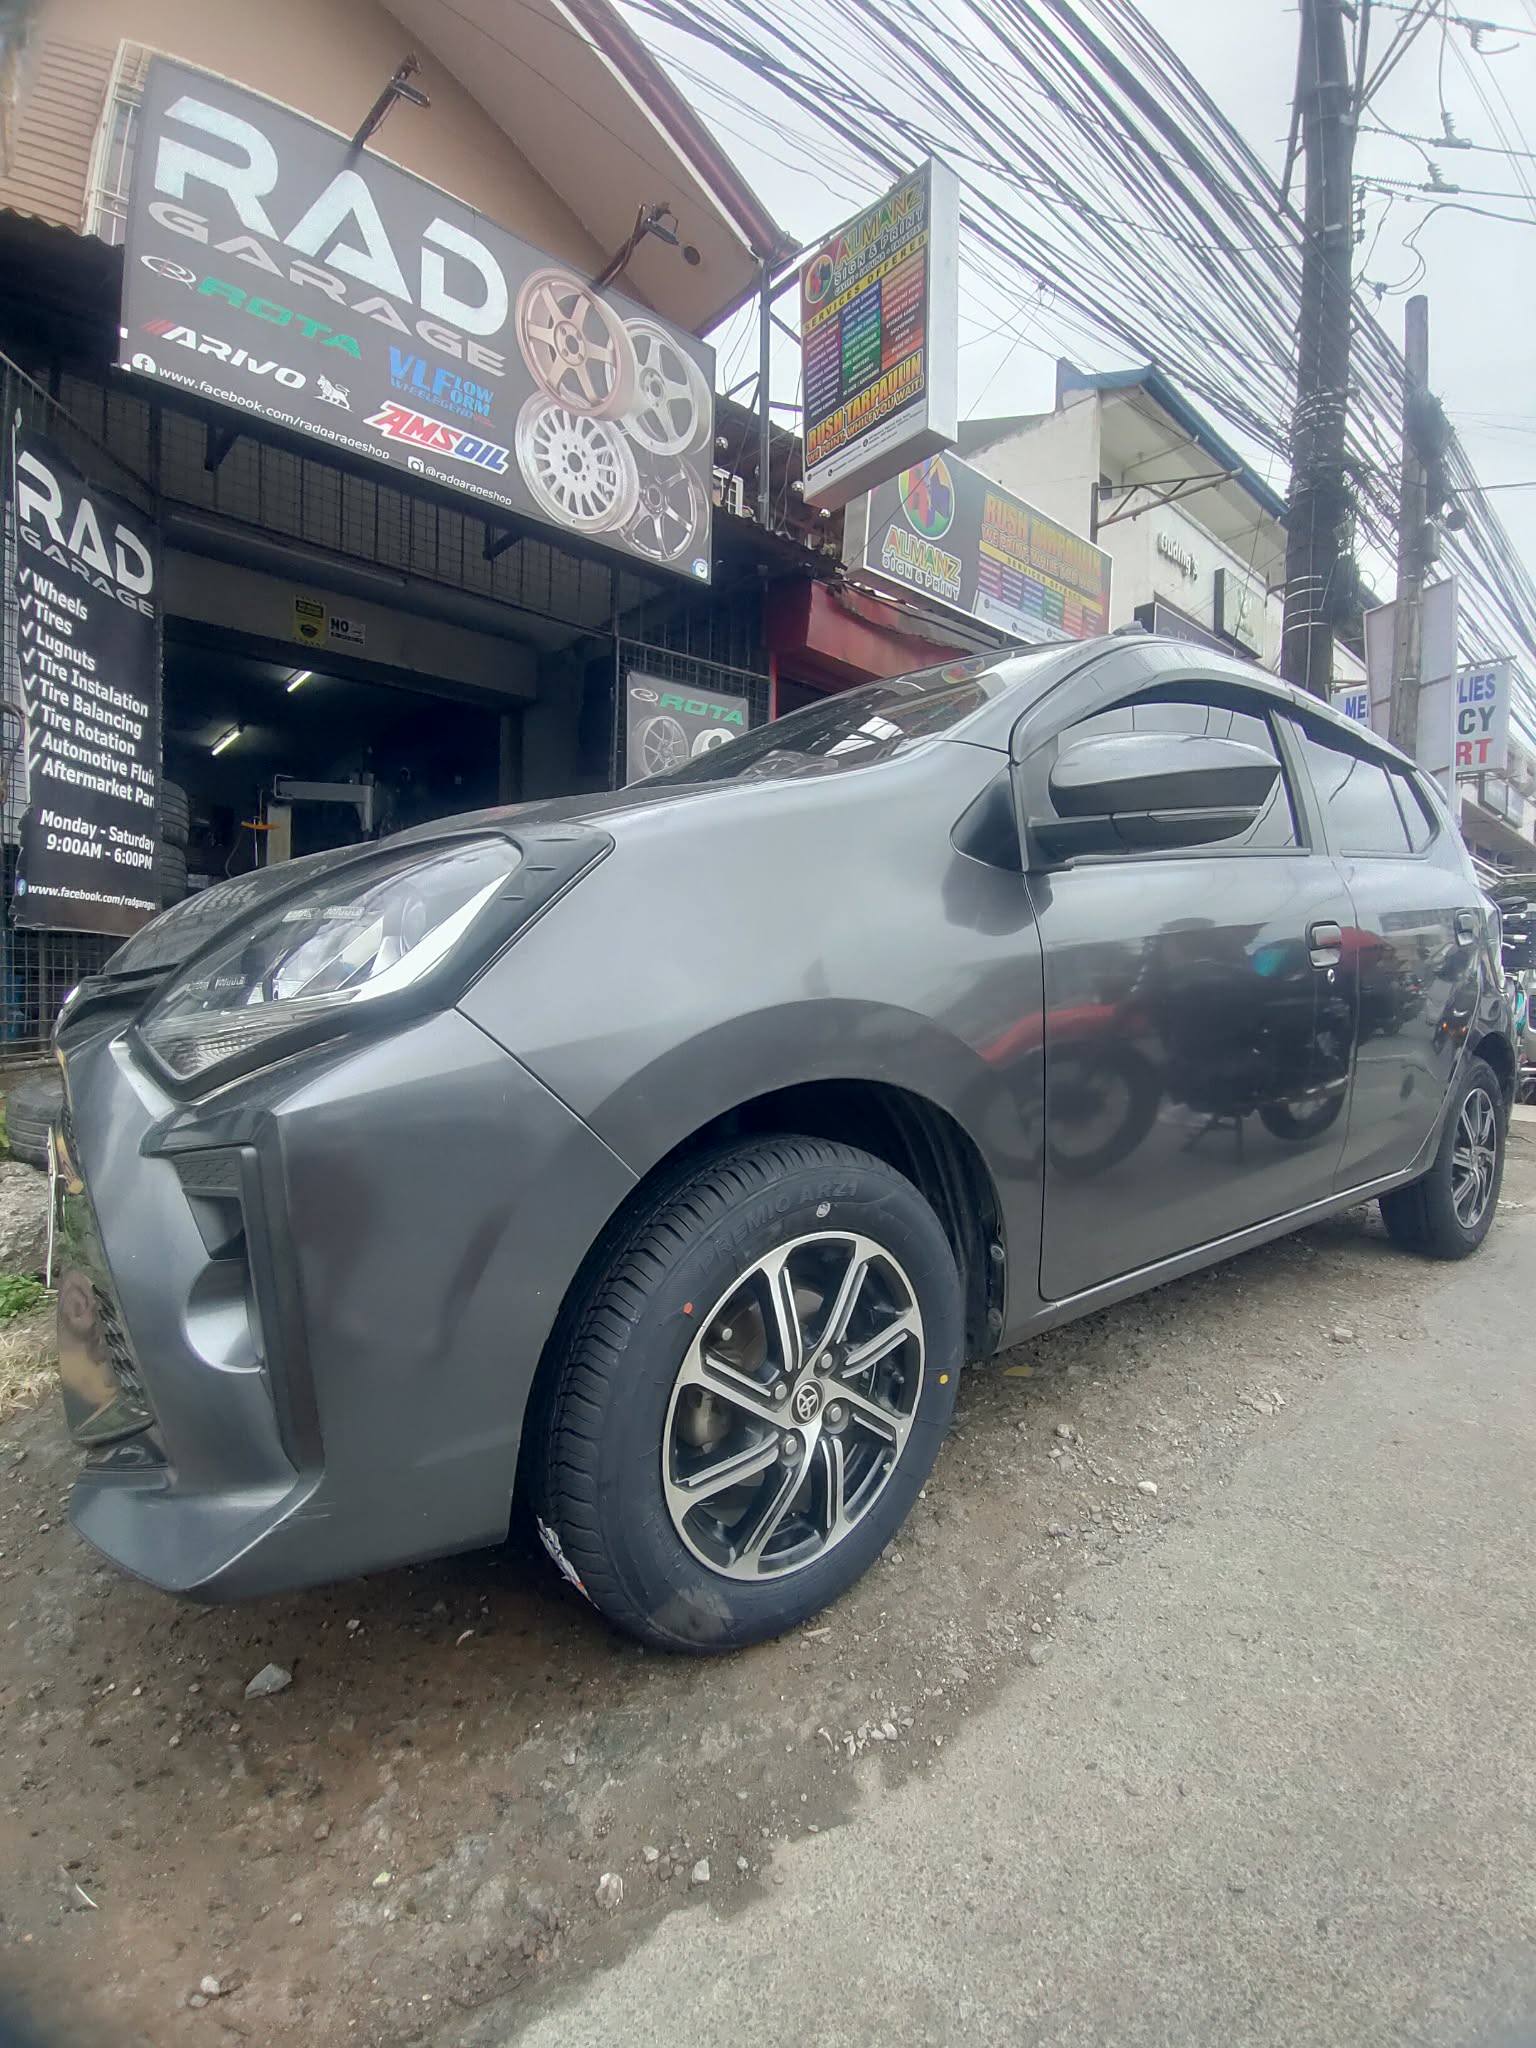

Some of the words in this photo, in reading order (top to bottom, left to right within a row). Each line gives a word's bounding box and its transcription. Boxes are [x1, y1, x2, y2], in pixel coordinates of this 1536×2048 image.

[155, 96, 508, 336] RAD
[834, 184, 925, 271] ALMANZ
[834, 253, 866, 286] SIGN
[880, 208, 924, 250] PRINT
[148, 202, 506, 376] GARAGE
[804, 284, 861, 330] SERVICES
[866, 234, 925, 285] OFFERED
[198, 275, 362, 360] ROTA
[161, 325, 307, 389] ARIVO
[807, 408, 844, 451] RUSH
[844, 352, 922, 425] TARPAULIN
[847, 413, 876, 438] WHILE
[875, 398, 896, 419] YOU
[369, 402, 509, 474] AMSOIL
[17, 450, 154, 595] RAD
[19, 525, 155, 620] GARAGE
[882, 524, 962, 587] ALMANZ
[882, 552, 913, 580] SIGN
[924, 573, 960, 602] PRINT
[33, 571, 88, 621] Wheels
[34, 600, 73, 636] Tires
[36, 625, 96, 672] Lugnuts
[330, 617, 350, 634] NO
[38, 650, 68, 682] Tire
[71, 668, 149, 719] Instalation
[39, 677, 69, 707] Tire
[72, 693, 142, 740] Balancing
[659, 692, 744, 727] ROTA
[1456, 673, 1496, 704] LIES
[41, 704, 71, 733] Tire
[75, 718, 136, 757] Rotation
[1458, 704, 1497, 735] CY
[41, 731, 128, 776] Automotive
[1455, 737, 1494, 767] RT
[41, 757, 133, 801] Aftermarket
[40, 808, 98, 840] Monday
[108, 826, 155, 854] Saturday
[46, 833, 101, 859] 9:00AM
[114, 848, 153, 870] 6:00PM
